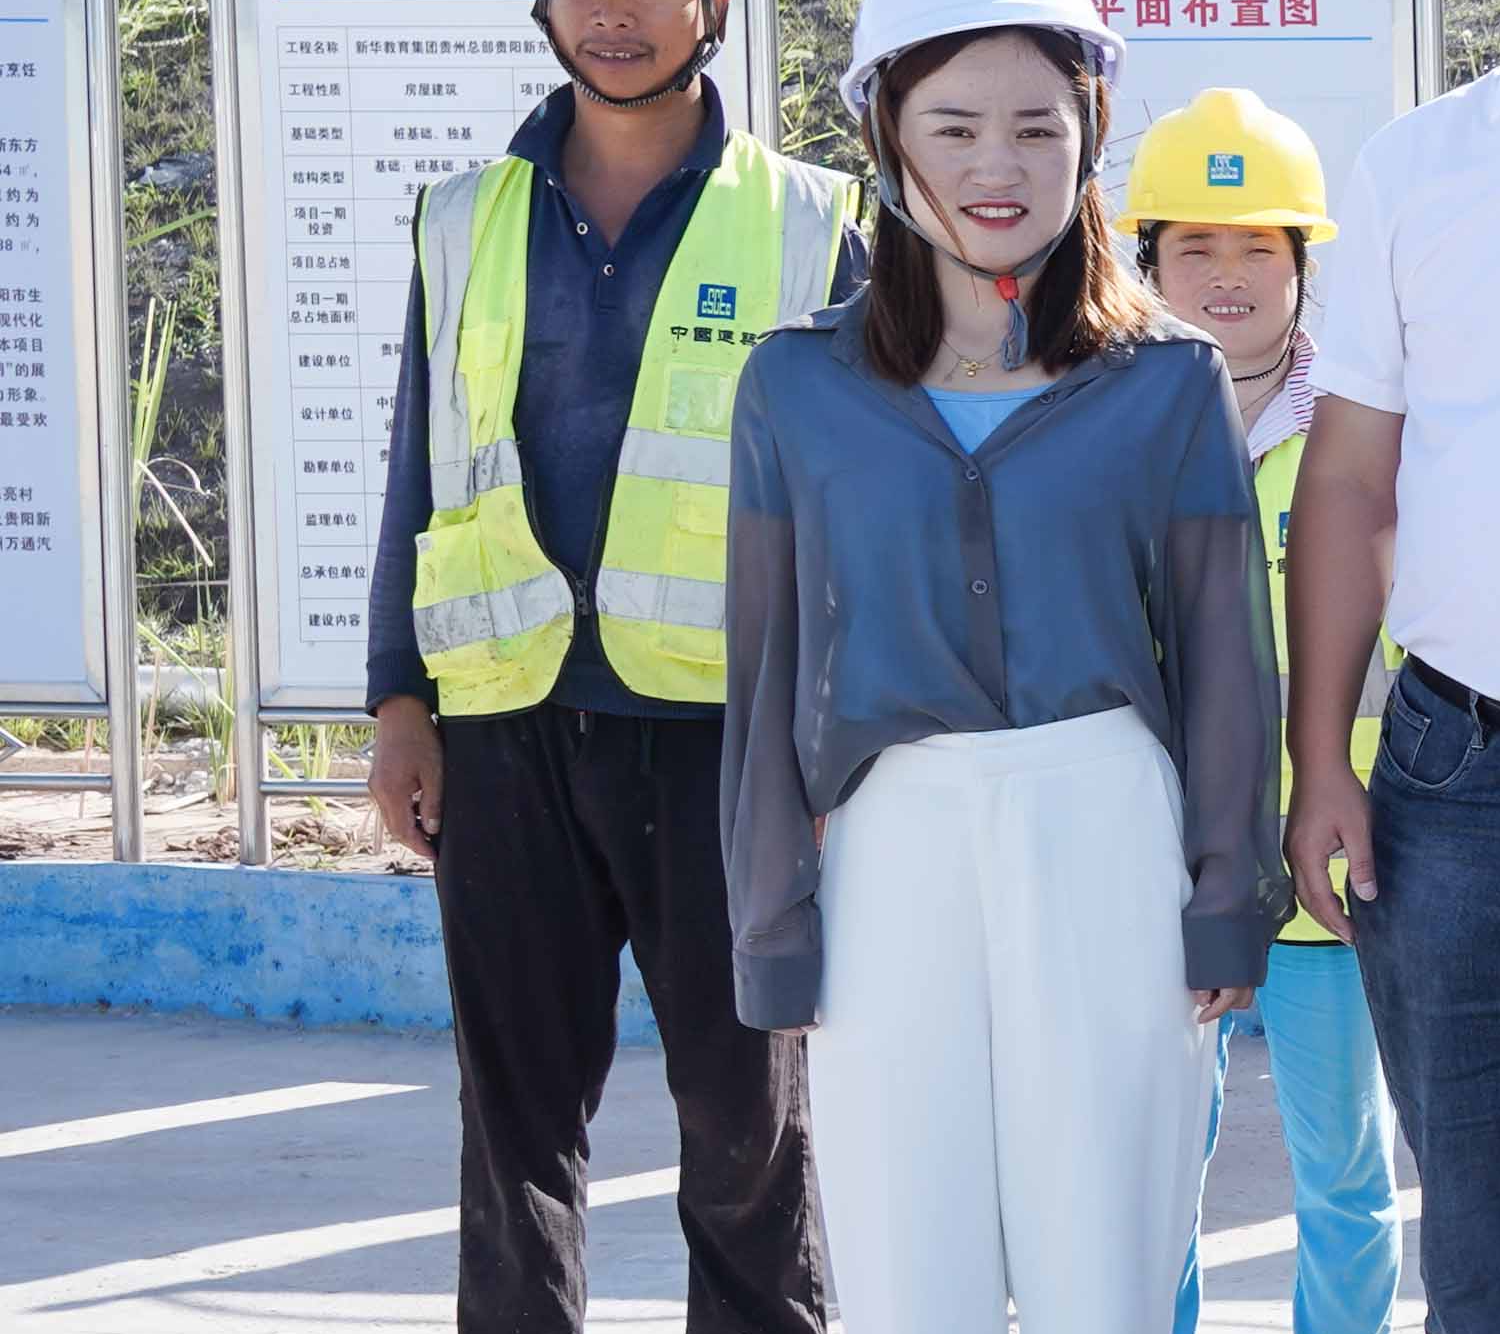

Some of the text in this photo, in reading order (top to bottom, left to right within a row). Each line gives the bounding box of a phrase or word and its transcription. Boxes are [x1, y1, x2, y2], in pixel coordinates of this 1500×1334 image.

[286, 41, 339, 54] 工程名称
[289, 83, 341, 97] 工程性质
[405, 83, 458, 97] 房屋建筑
[291, 127, 344, 140] 基础类型
[393, 127, 472, 141] 桩基础、独基
[293, 171, 345, 185] 结构类型
[294, 206, 347, 220] 项目一期
[308, 222, 333, 236] 投资
[291, 256, 350, 269] 项目总占地
[295, 291, 348, 305] 项目一期
[290, 310, 356, 323] 总占地面积
[299, 354, 352, 367] 建设单位
[302, 407, 353, 421] 设计单位
[303, 460, 356, 474] 勘察单位
[0, 511, 50, 527] 贵阳新
[305, 513, 358, 527] 监理单位
[0, 536, 51, 552] 万通汽
[301, 565, 367, 580] 总承包单位
[308, 614, 361, 627] 建设内容
